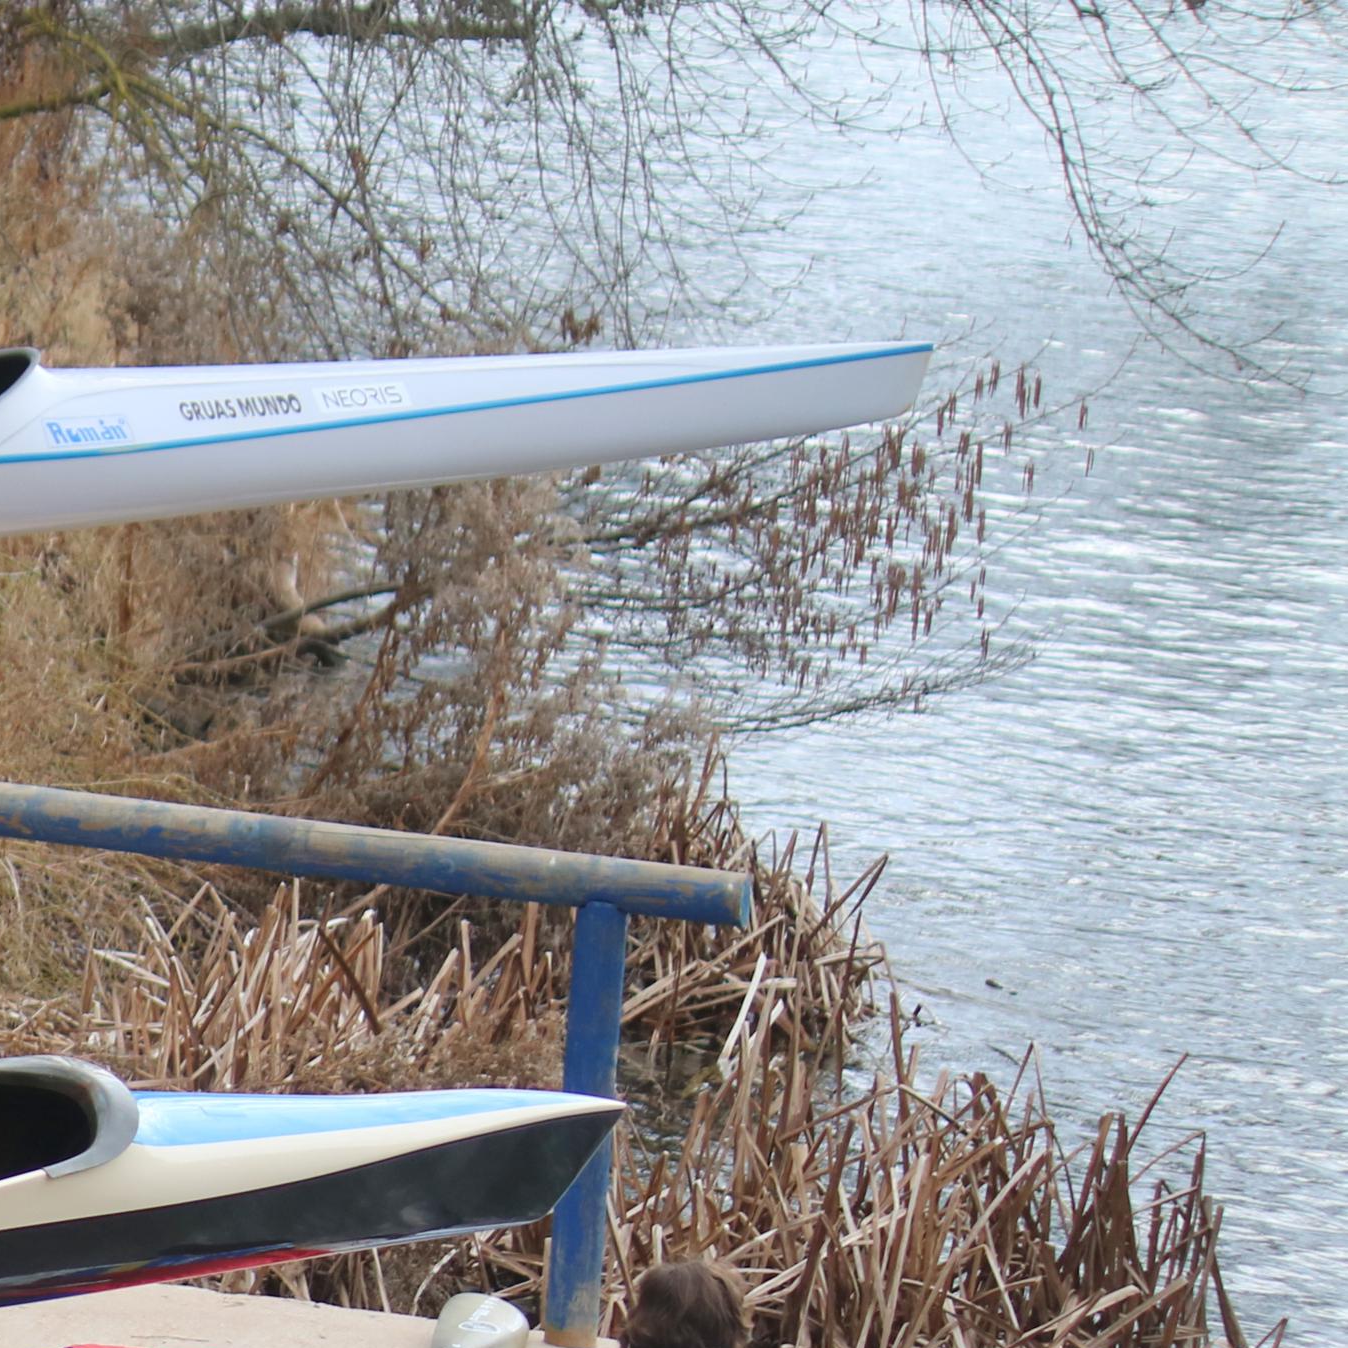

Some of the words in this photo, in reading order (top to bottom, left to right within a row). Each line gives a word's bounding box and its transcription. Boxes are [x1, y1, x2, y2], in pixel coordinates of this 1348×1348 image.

[179, 400, 236, 421] GRUAS
[239, 393, 302, 417] MUNDO
[321, 385, 404, 409] NEORIS
